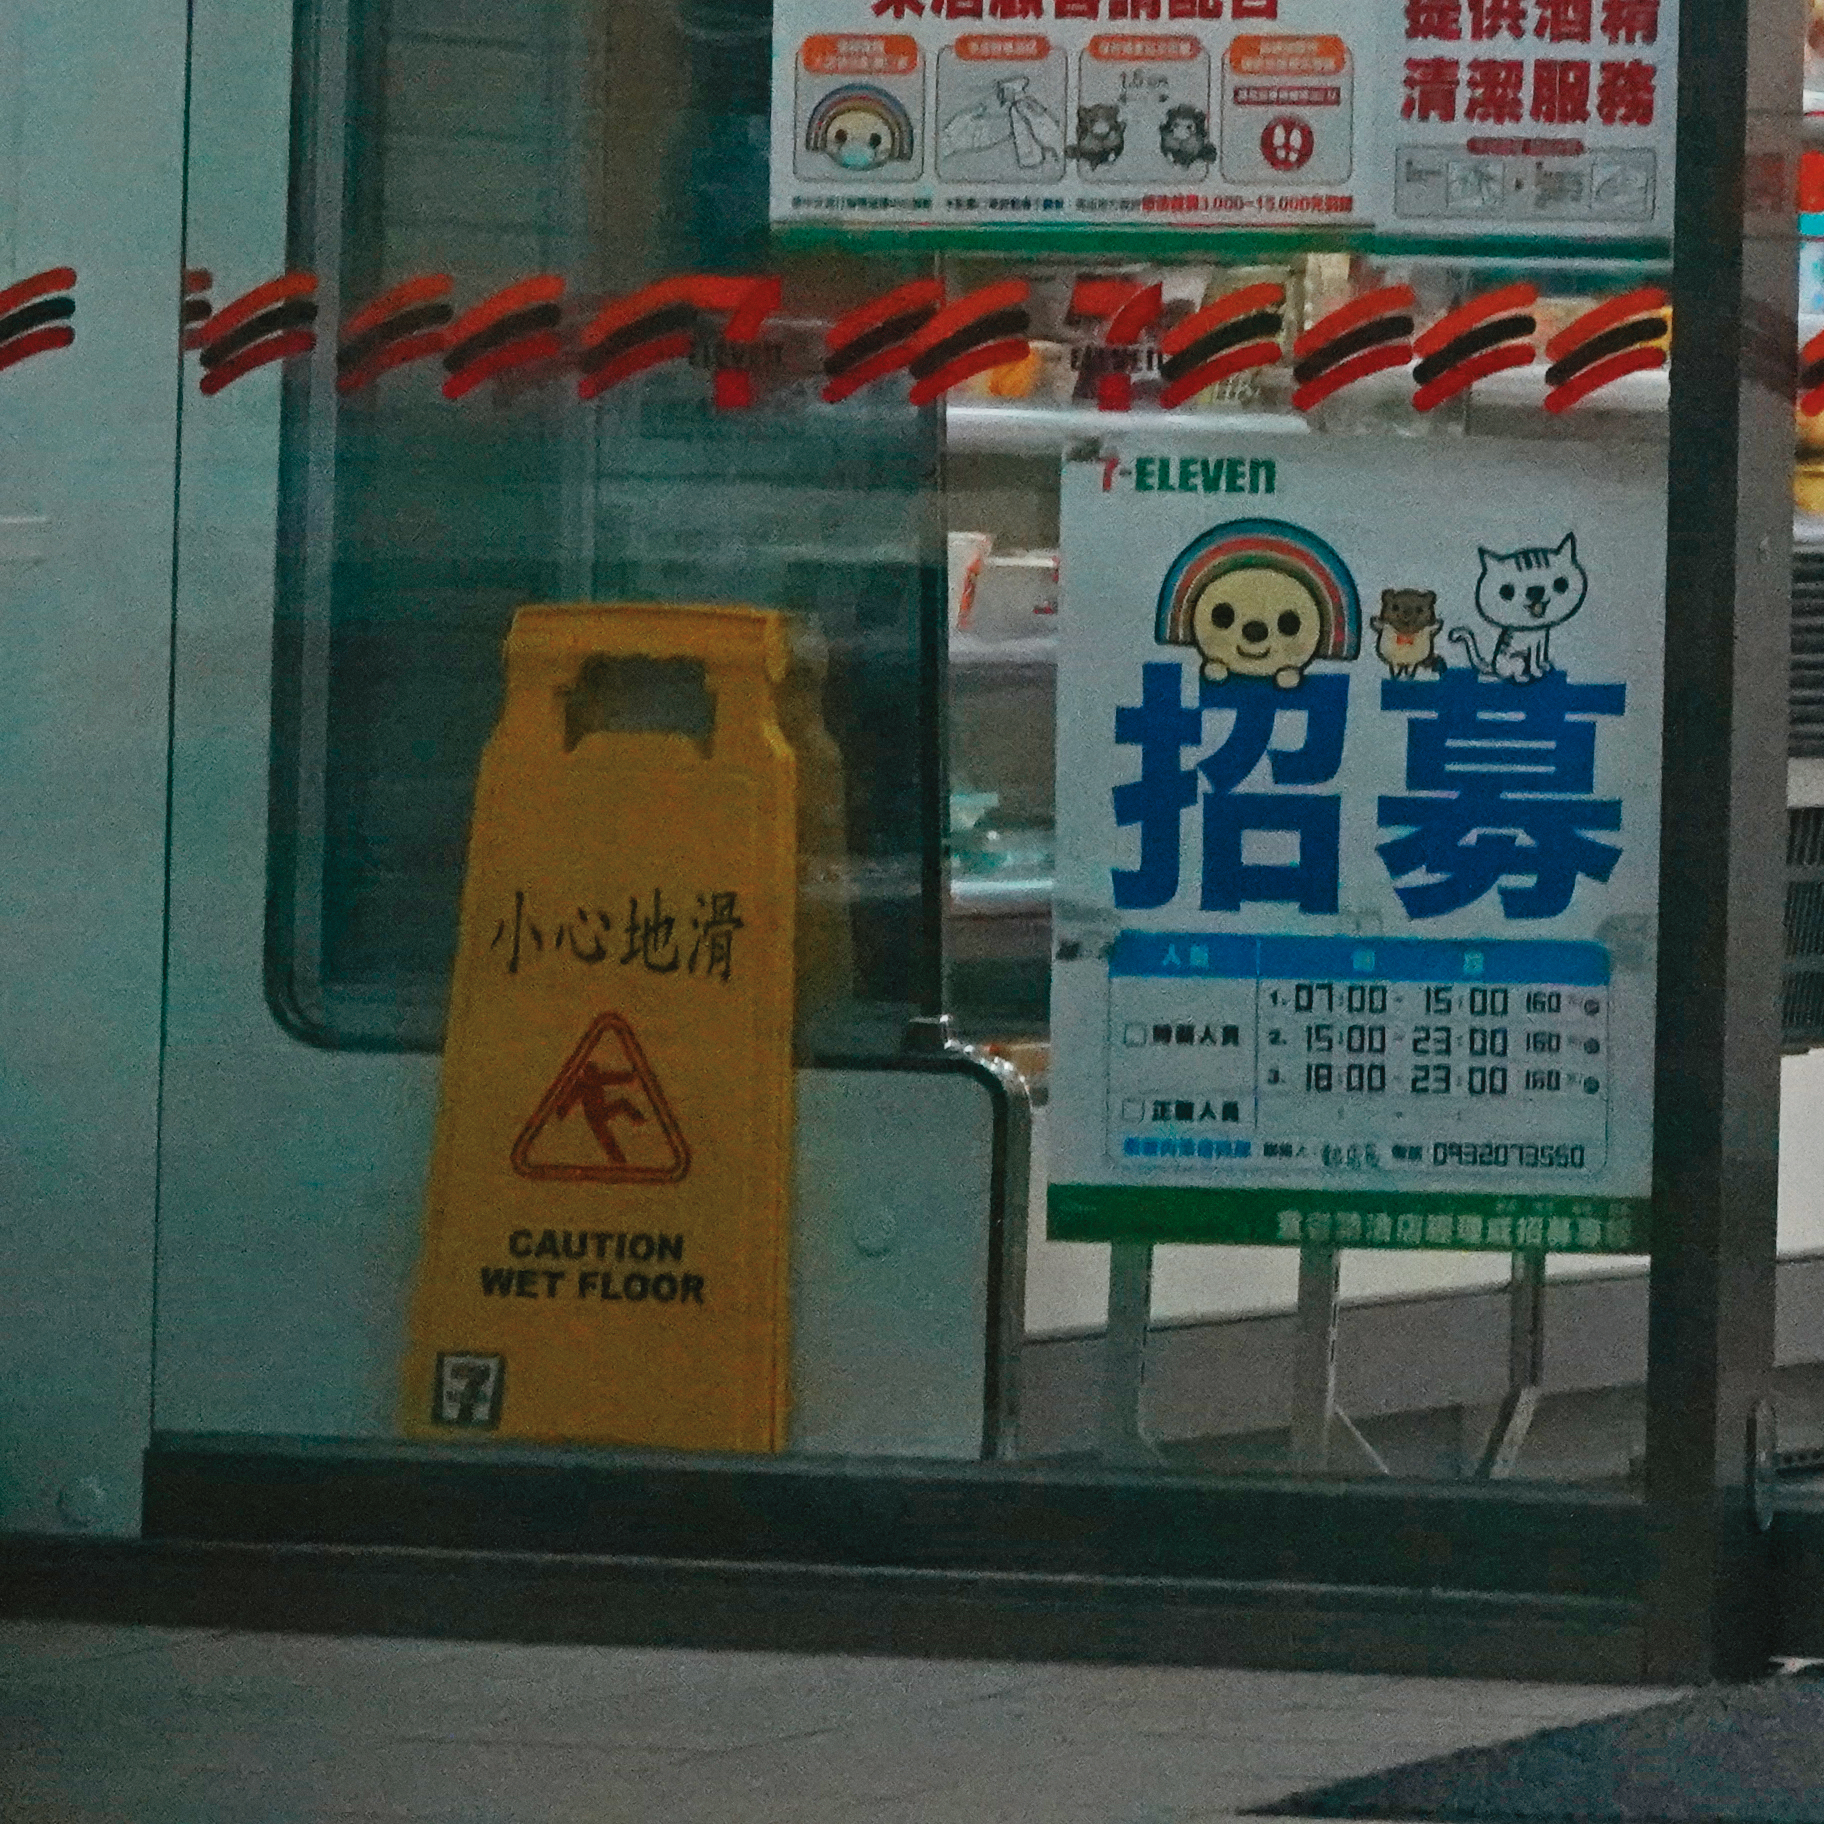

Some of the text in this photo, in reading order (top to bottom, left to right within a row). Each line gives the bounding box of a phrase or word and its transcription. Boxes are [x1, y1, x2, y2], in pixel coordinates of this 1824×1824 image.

[1401, 56, 1659, 127] 清潔服務
[1110, 660, 1628, 921] 招募
[490, 888, 746, 981] 小心地滑
[507, 1227, 685, 1266] CAUTION
[480, 1266, 706, 1307] WET FLOOR
